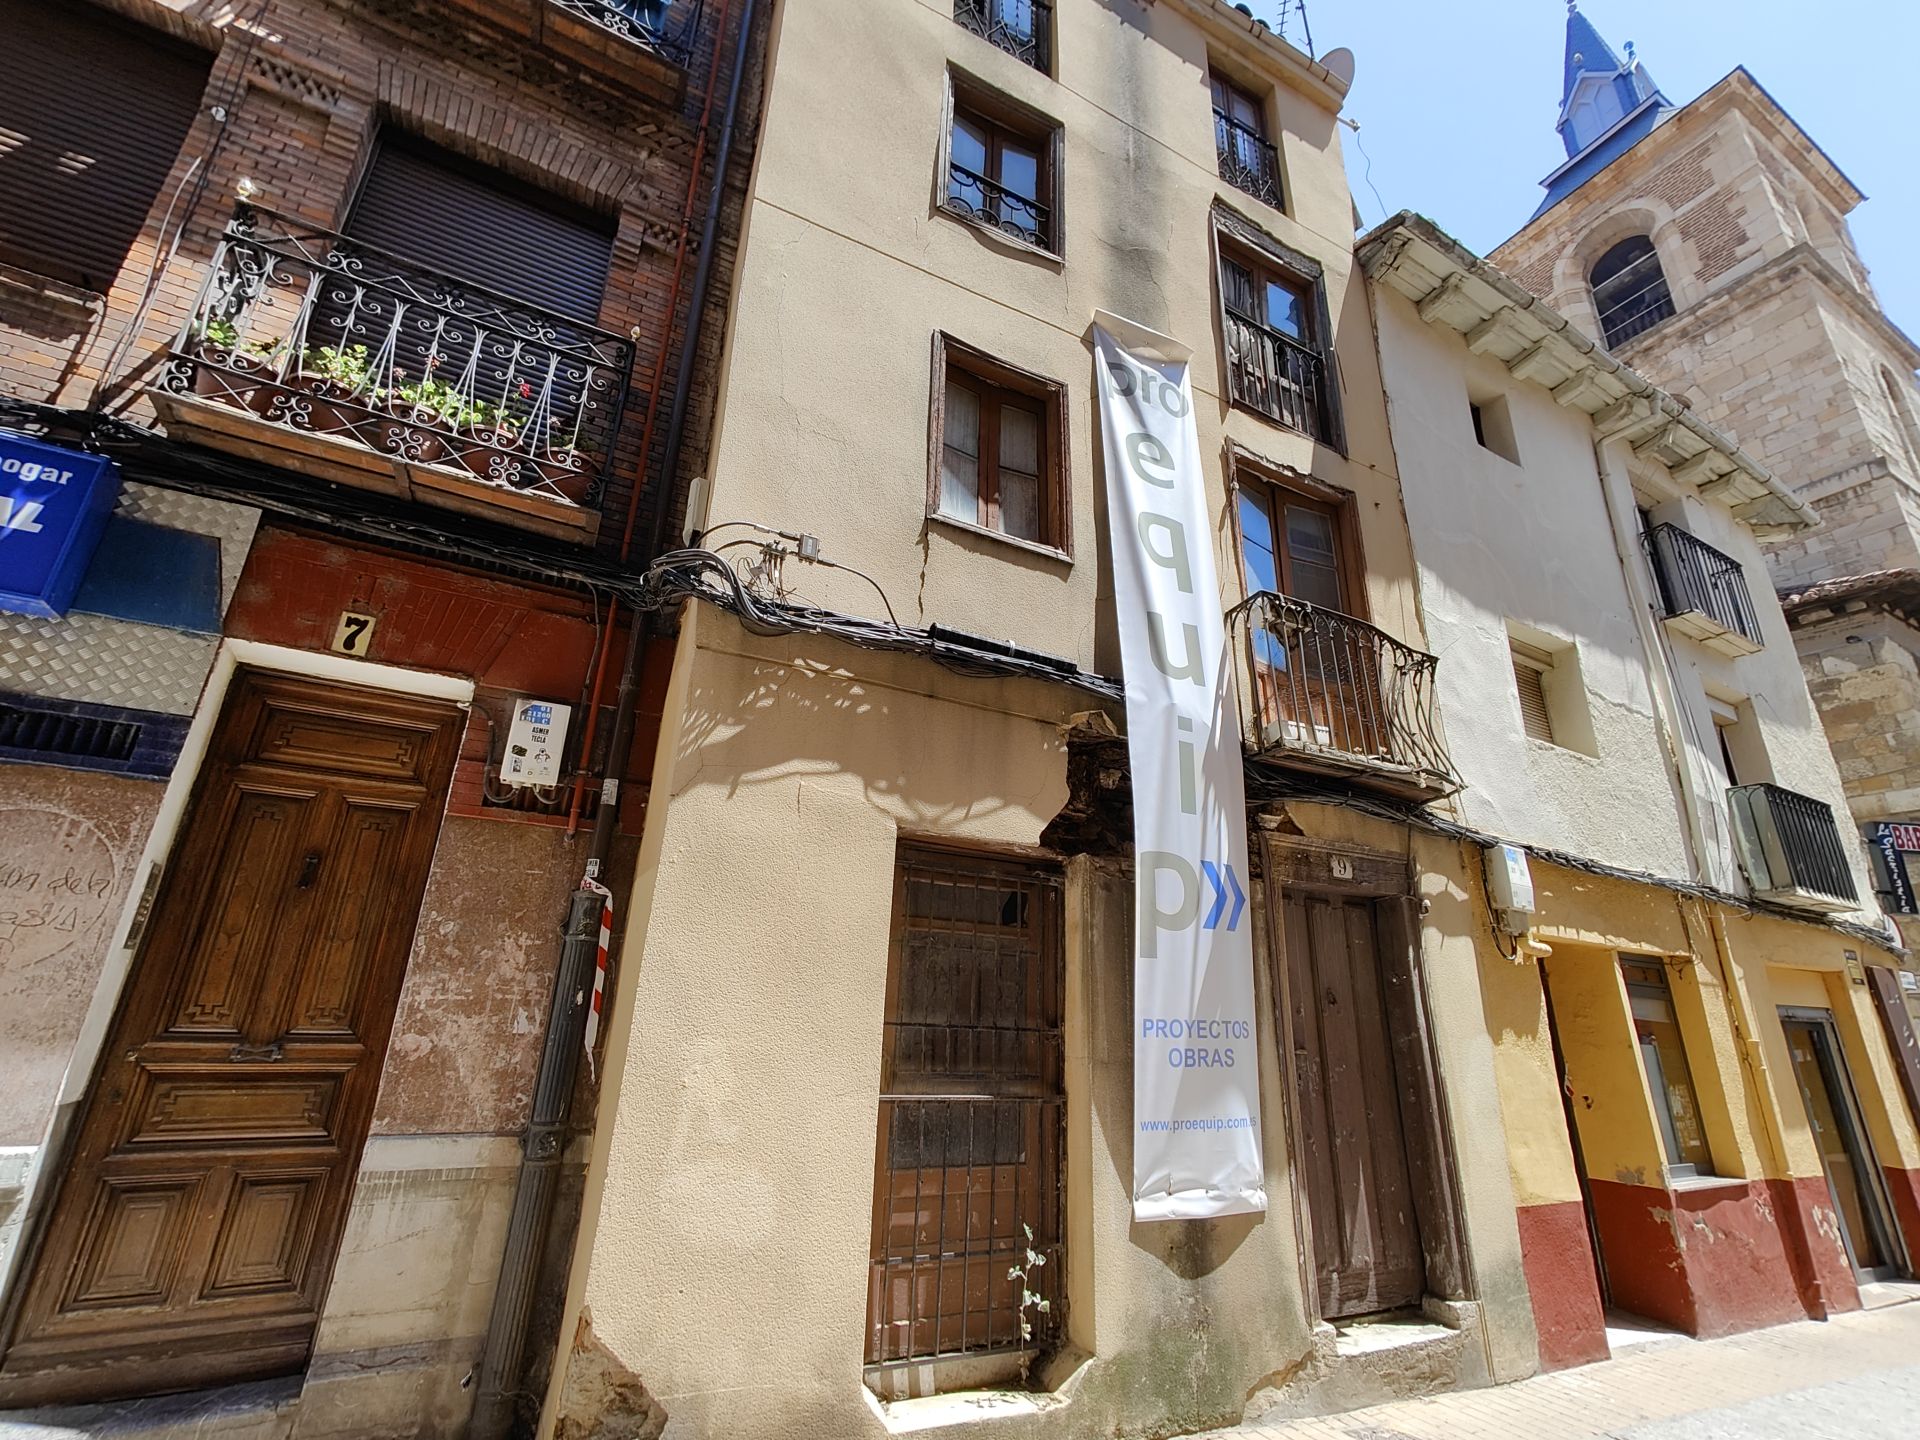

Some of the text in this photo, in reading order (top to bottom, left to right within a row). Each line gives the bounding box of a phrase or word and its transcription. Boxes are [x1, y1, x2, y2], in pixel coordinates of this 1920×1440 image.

[0, 456, 73, 485] ogar
[343, 616, 369, 650] 7
[1142, 1018, 1250, 1039] PROYECTOS
[1168, 1048, 1235, 1068] OBRAS
